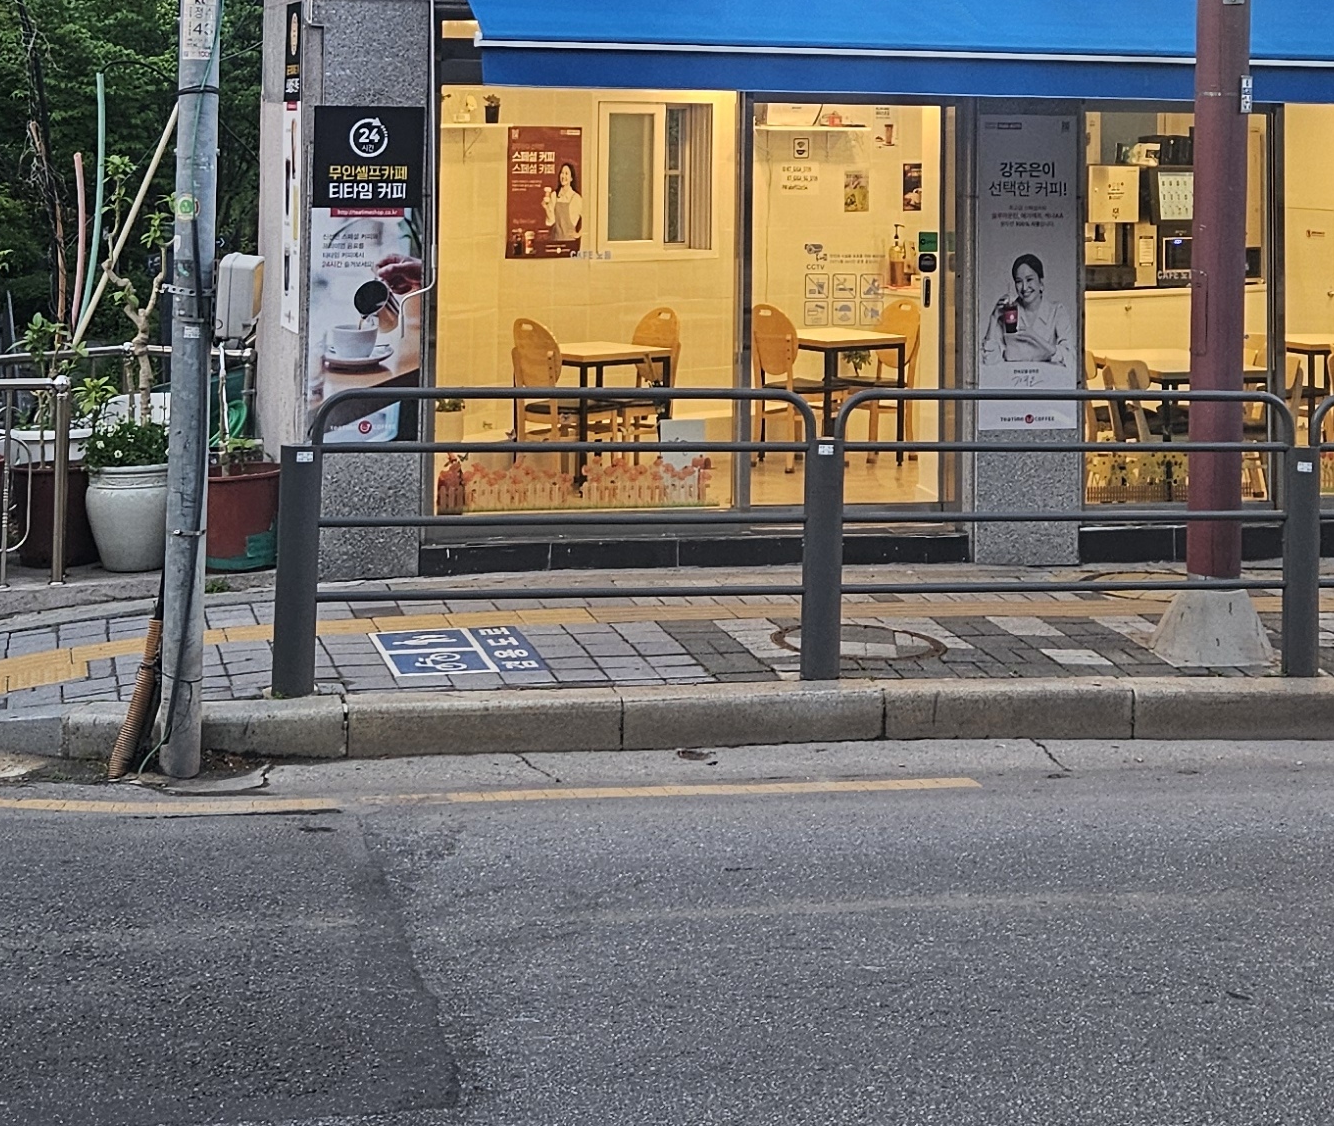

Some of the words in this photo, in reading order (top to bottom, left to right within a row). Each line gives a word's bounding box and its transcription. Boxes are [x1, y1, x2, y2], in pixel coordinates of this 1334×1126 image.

[358, 127, 380, 143] 24
[361, 144, 375, 153] 시간
[328, 165, 408, 181] 무인셀프카페
[999, 161, 1056, 179] 강주은이
[328, 182, 373, 200] 티타임
[377, 182, 407, 200] 커피
[988, 180, 1031, 197] 선택한
[1035, 180, 1067, 197] 커피!
[806, 263, 826, 271] CCTV
